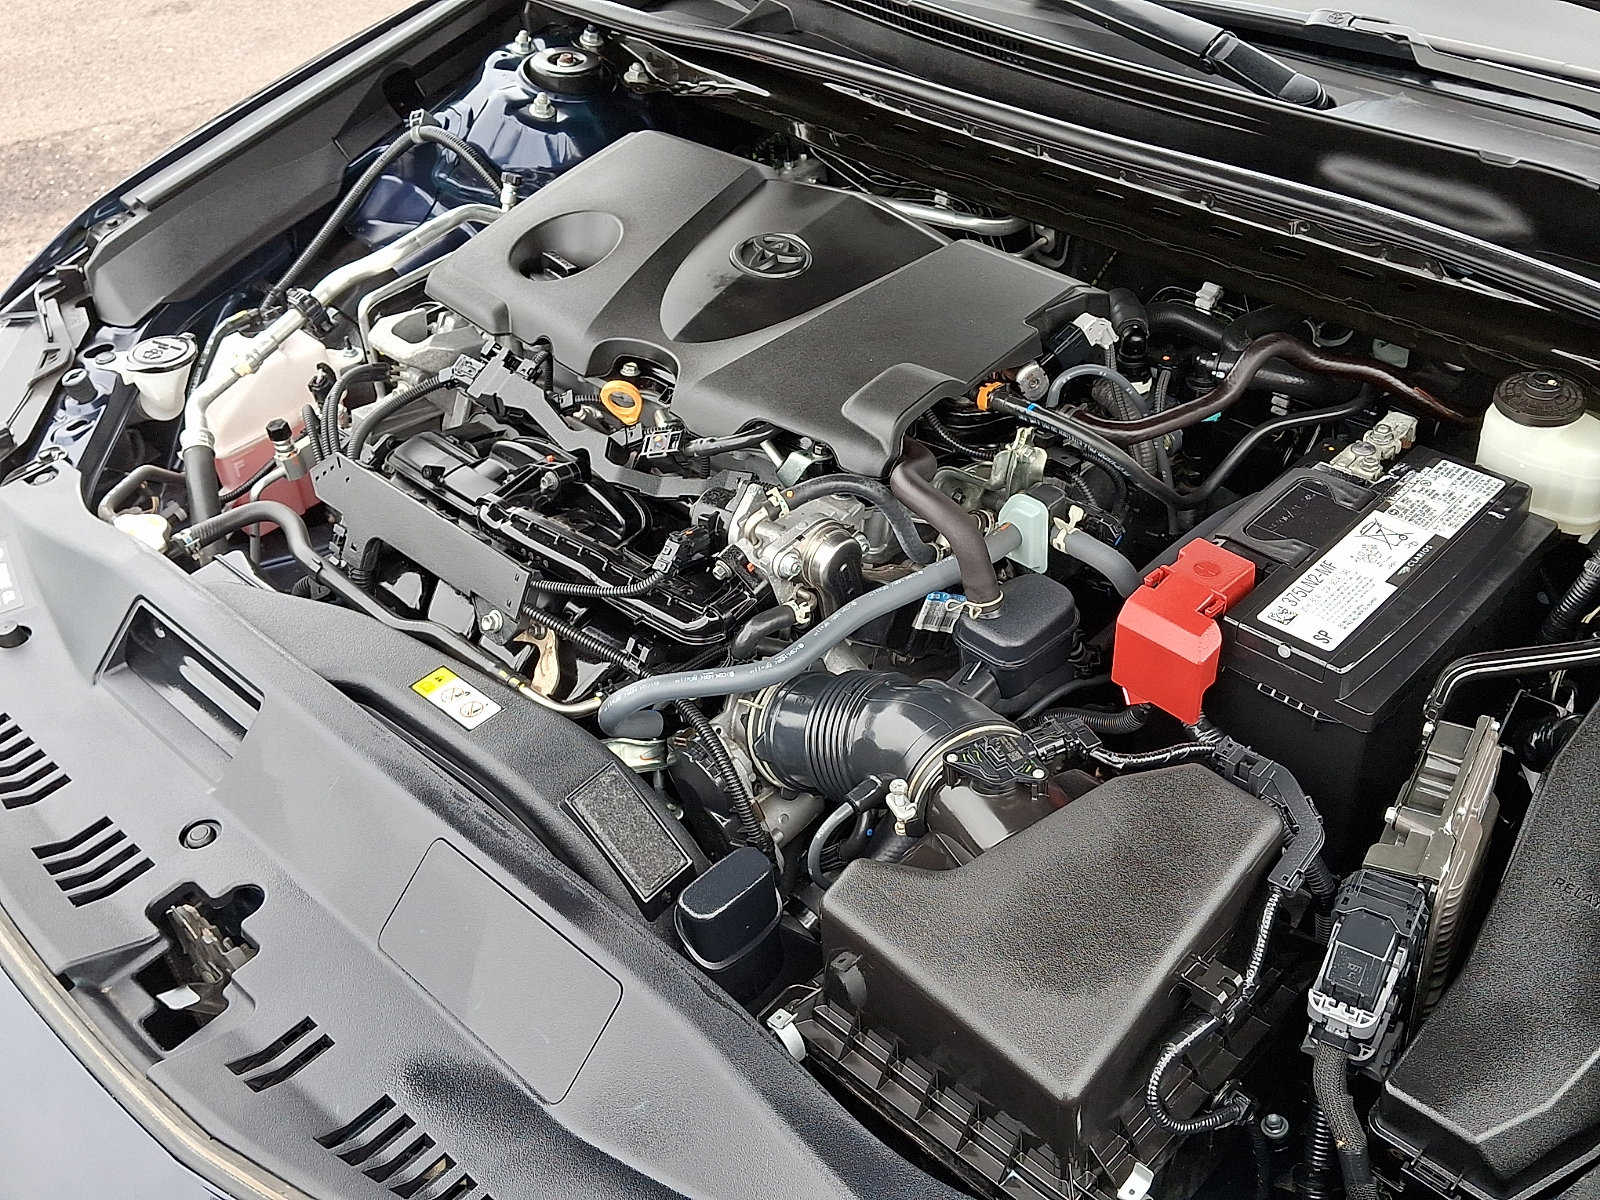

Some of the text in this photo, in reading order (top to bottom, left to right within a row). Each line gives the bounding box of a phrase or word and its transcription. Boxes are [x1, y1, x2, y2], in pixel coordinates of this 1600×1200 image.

[1407, 544, 1434, 568] CLARIOS
[1282, 559, 1338, 608] 375LN2-MF
[1313, 629, 1334, 645] SP
